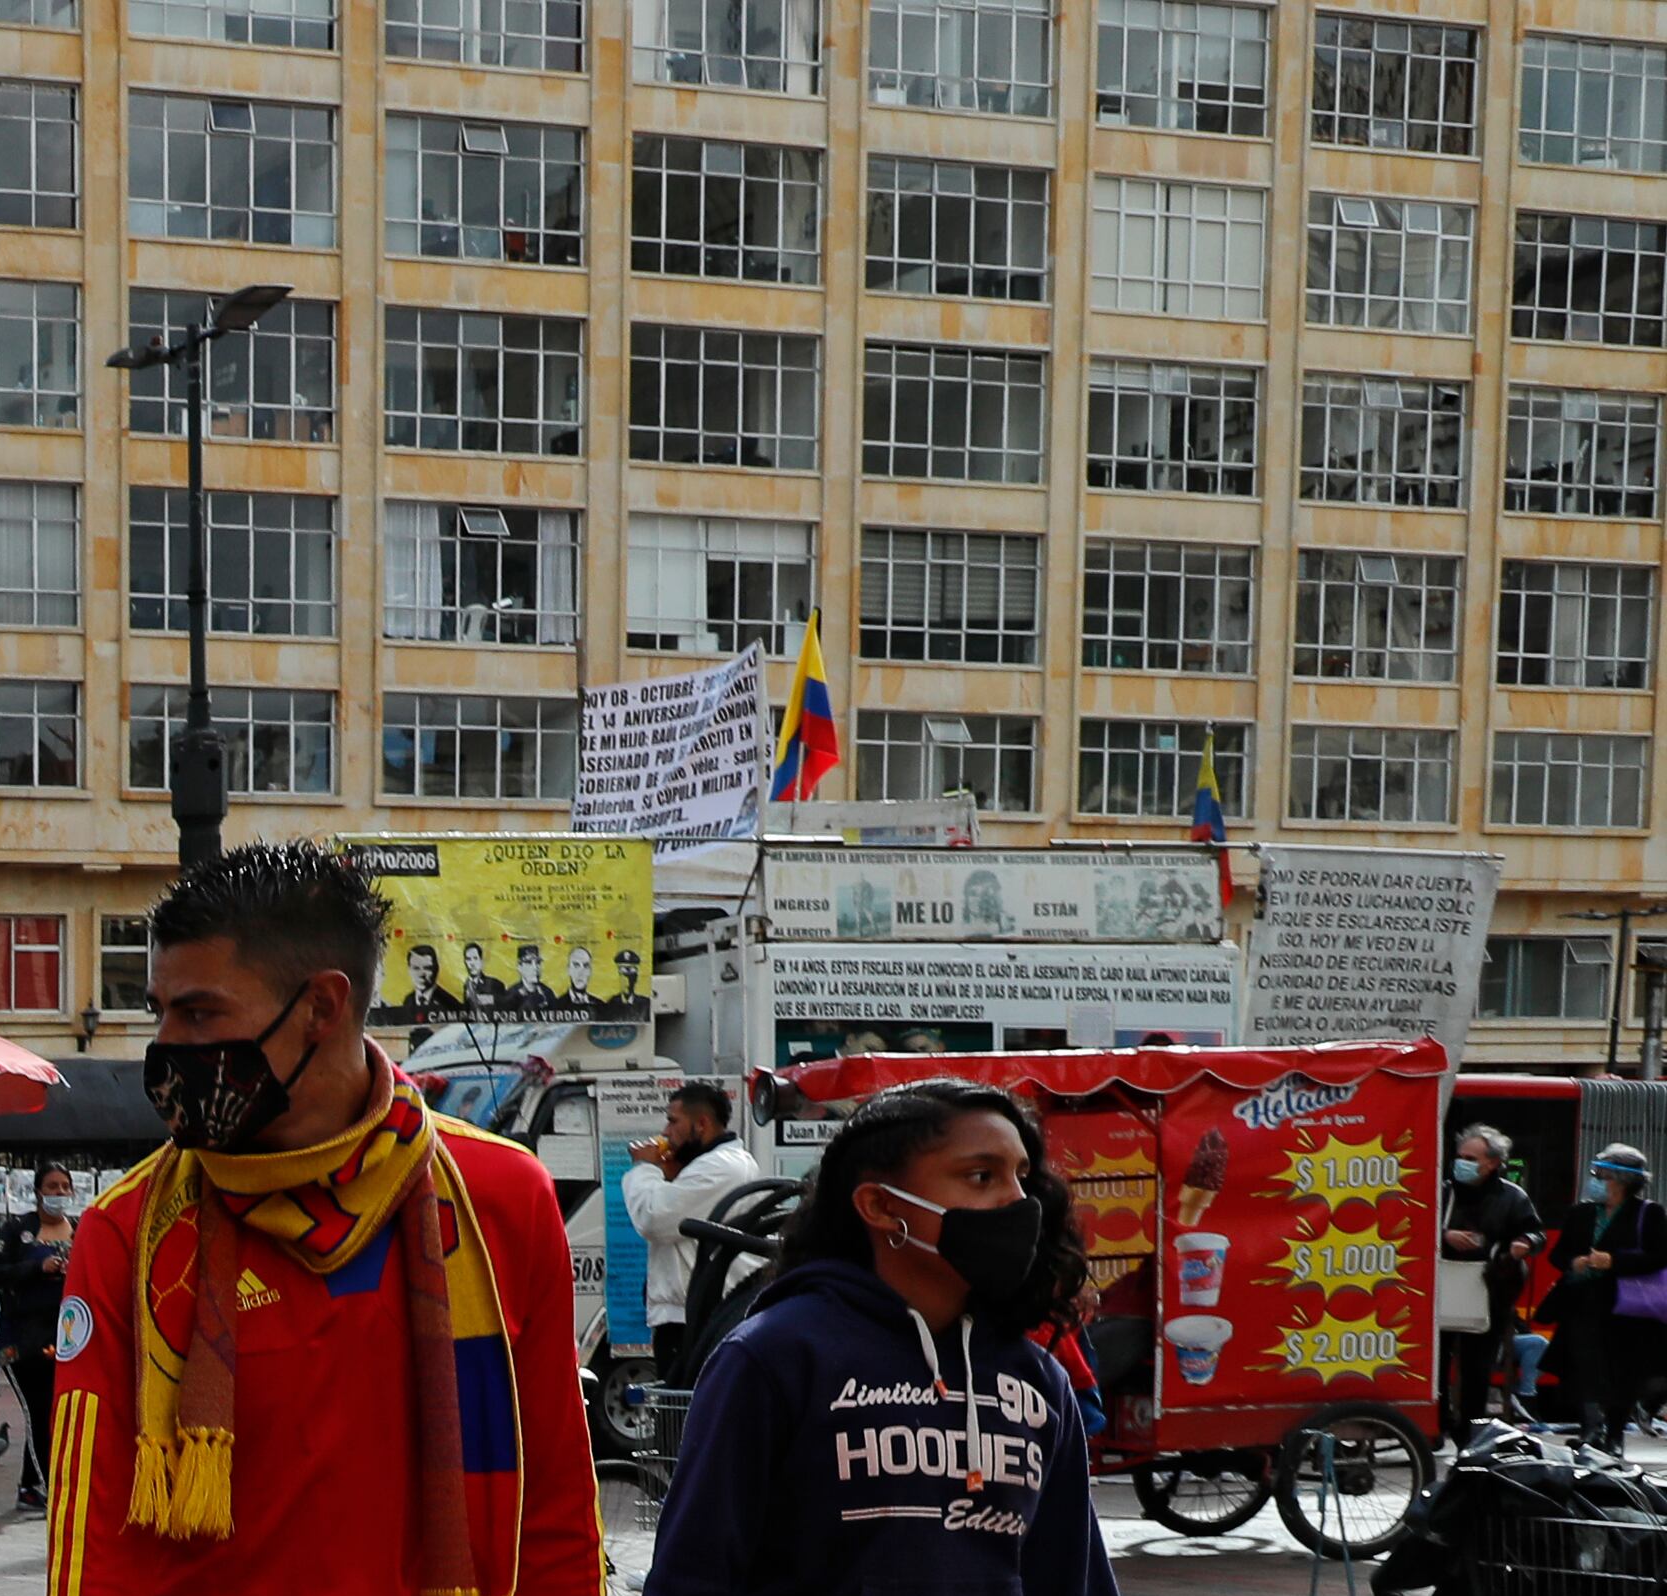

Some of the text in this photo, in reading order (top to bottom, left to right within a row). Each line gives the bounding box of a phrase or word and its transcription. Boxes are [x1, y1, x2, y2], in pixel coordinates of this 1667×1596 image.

[601, 733, 616, 751] MI
[561, 845, 593, 860] DIO
[605, 845, 627, 860] LA
[522, 860, 589, 876] ORDEN?
[1298, 871, 1473, 894] SE DAR CUENTA
[1313, 889, 1352, 906] AÑOS
[1357, 894, 1434, 911] LUCHANDO
[897, 902, 954, 924] ME LO
[1317, 914, 1333, 928] SE
[1310, 934, 1417, 952] HOY ME VEO EN
[774, 960, 786, 973] EN
[789, 960, 799, 974] 14
[831, 960, 859, 975] ESTOS
[862, 961, 903, 975] FISCALES
[906, 961, 924, 976] HAN
[927, 962, 972, 977] CONOCIDO
[976, 963, 985, 977] EL
[988, 964, 1011, 978] CASO
[1015, 964, 1030, 978] DEL
[1034, 965, 1079, 980] ASESINATO
[1082, 966, 1097, 980] DEL
[1100, 966, 1123, 981] CABO
[1150, 968, 1187, 982] ANTONIO
[1190, 969, 1230, 984] CARVAJAL
[1327, 956, 1350, 971] DE
[828, 981, 839, 995] LA
[908, 983, 918, 997] DE
[922, 983, 933, 997] LA
[959, 984, 970, 998] DE
[1008, 985, 1018, 999] DE
[1021, 986, 1052, 1000] NACIDA
[1062, 987, 1073, 1000] LA
[1122, 988, 1133, 1001] NO
[1136, 988, 1153, 1002] HAN
[1156, 989, 1183, 1004] HECHO
[1186, 989, 1208, 1003] NADA
[1211, 990, 1230, 1004] PARA
[1328, 976, 1350, 991] DE
[774, 1002, 793, 1017] QUE
[795, 1002, 806, 1016] SE
[808, 1002, 861, 1017] INVESTIGUE
[864, 1003, 874, 1017] EL
[910, 1004, 928, 1018] SON
[931, 1004, 984, 1020] COMPLICES?
[1284, 996, 1303, 1011] ME
[1307, 996, 1365, 1012] QUIERAN
[493, 1010, 589, 1022] POR LA VERDAD
[786, 1124, 811, 1139] Juan
[1323, 1155, 1399, 1189] 1.000
[1320, 1242, 1397, 1277] 1.000
[1313, 1330, 1397, 1363] 2.000
[830, 1377, 939, 1411] Limited
[836, 1426, 1043, 1491] HOODIES
